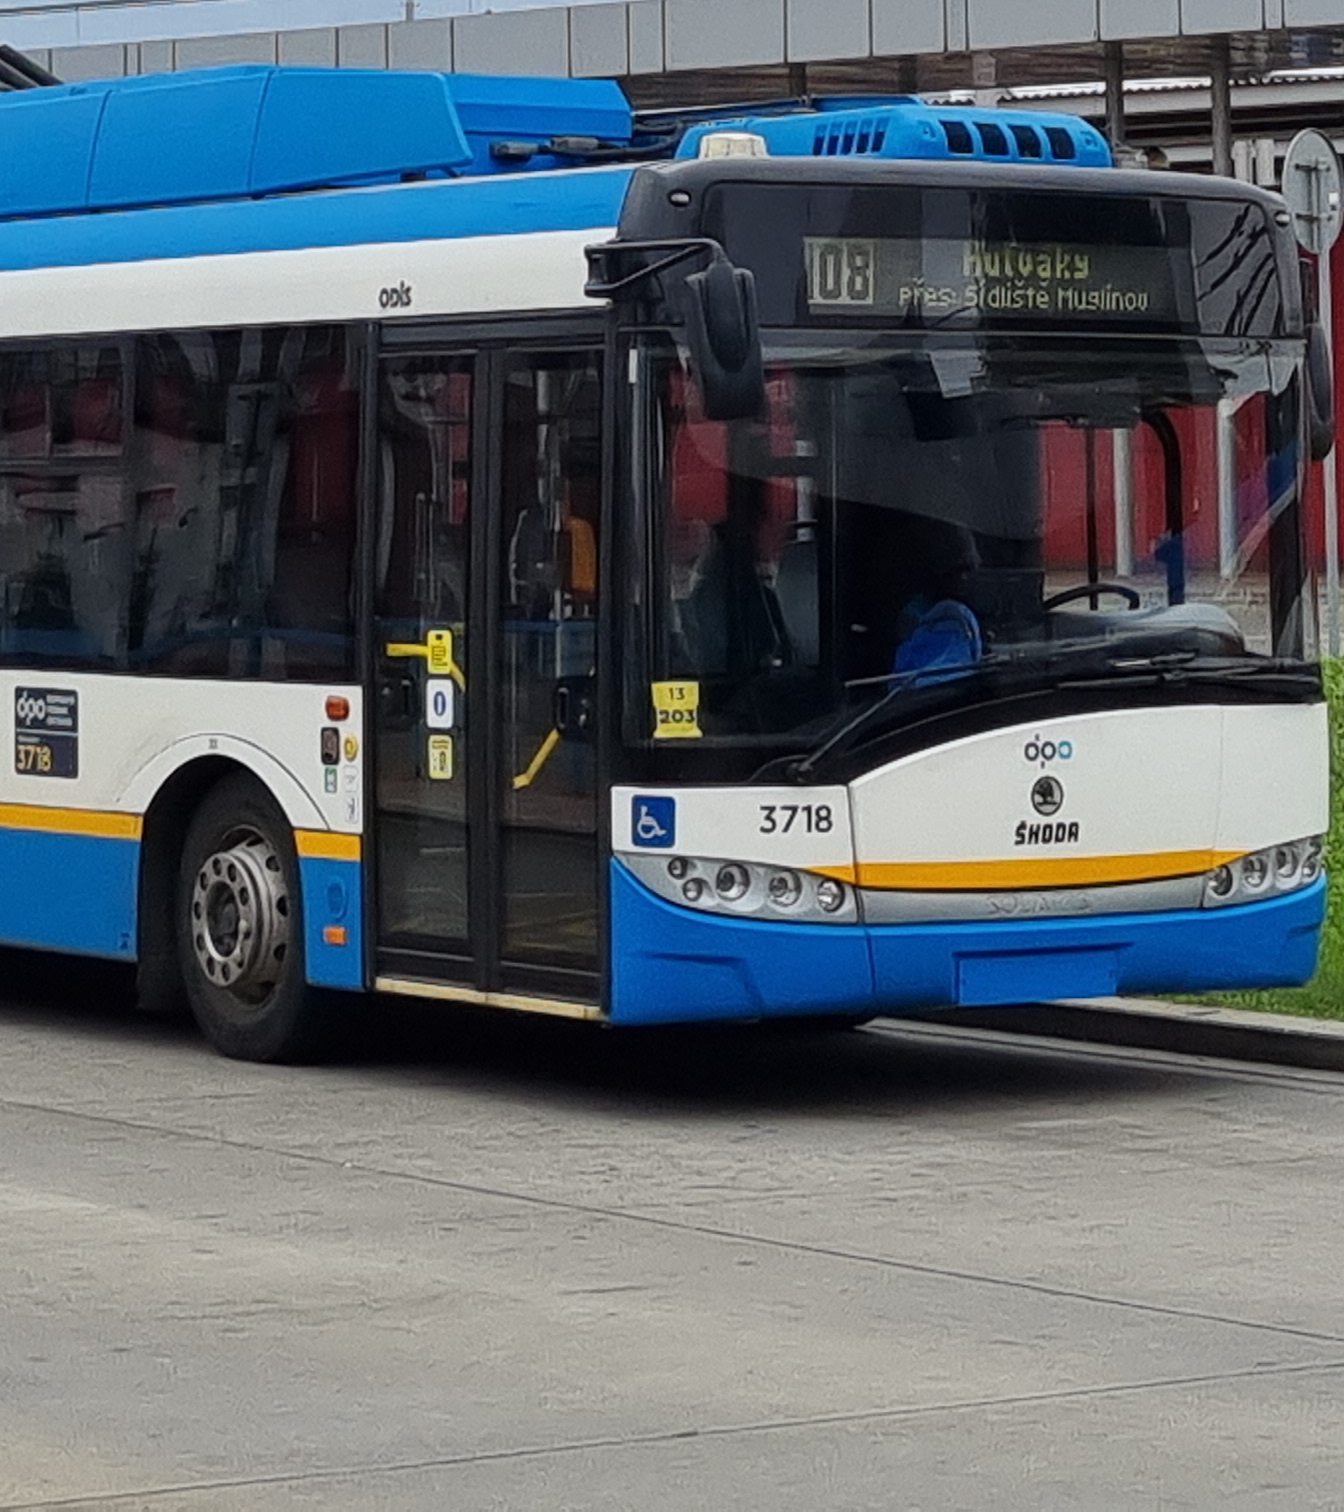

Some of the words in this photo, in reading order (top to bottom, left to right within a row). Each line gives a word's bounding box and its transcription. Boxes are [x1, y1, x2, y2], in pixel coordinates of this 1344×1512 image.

[961, 240, 1090, 279] Hulváky
[669, 687, 686, 701] 13
[659, 709, 696, 724] 203
[759, 804, 833, 834] 3718
